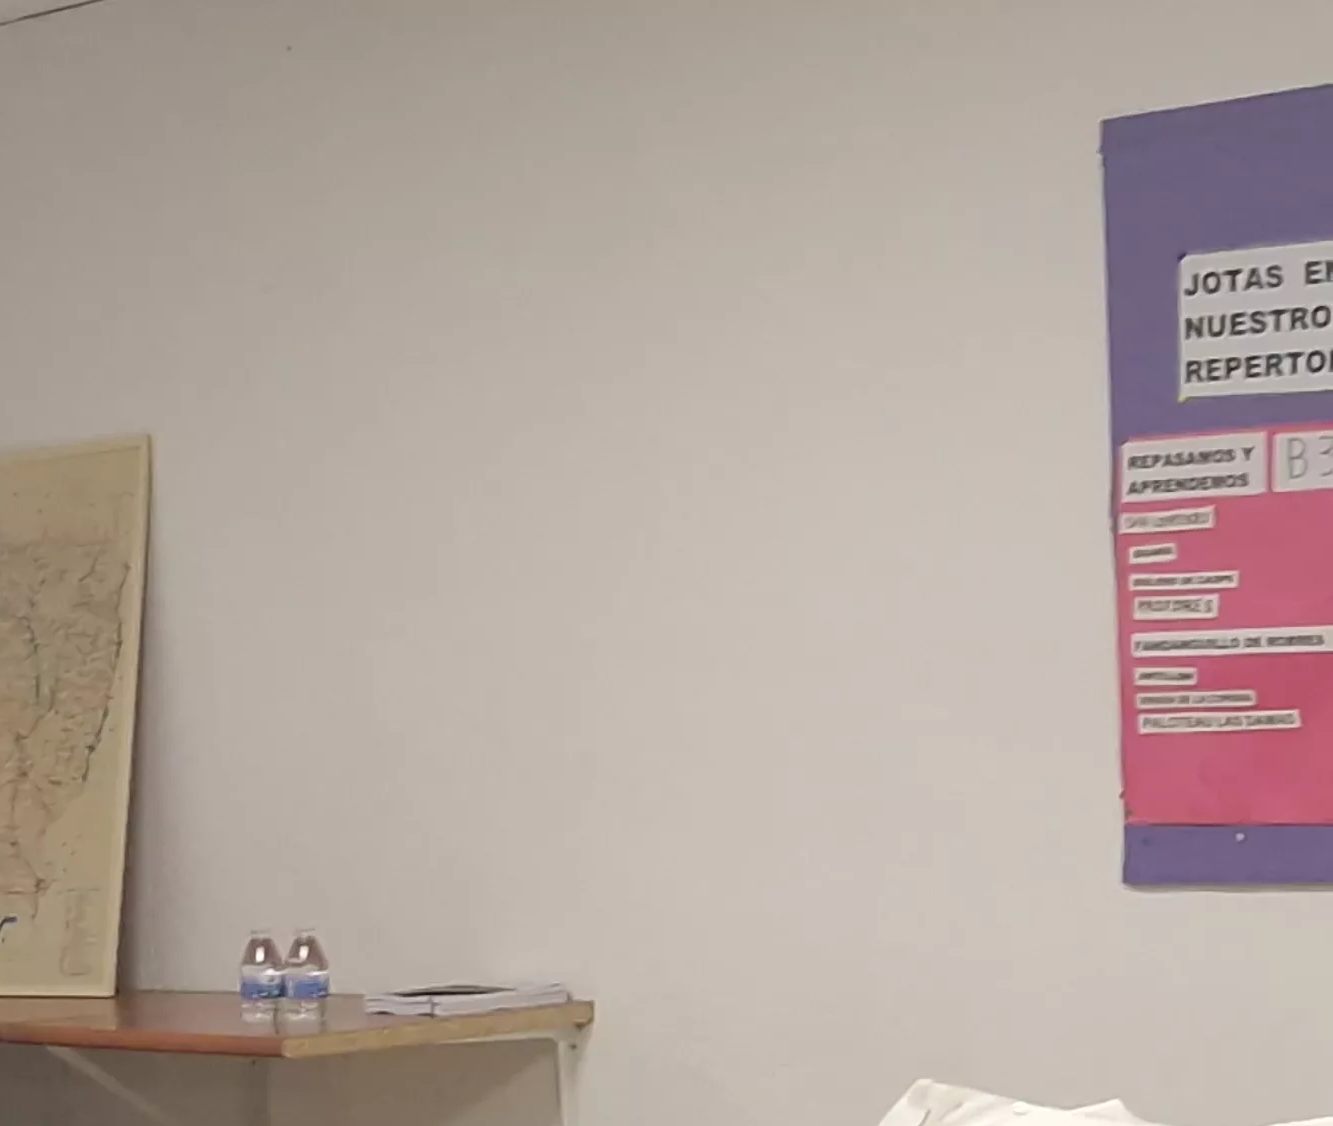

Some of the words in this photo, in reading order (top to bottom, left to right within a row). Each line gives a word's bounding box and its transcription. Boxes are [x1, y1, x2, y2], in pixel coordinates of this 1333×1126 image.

[1184, 264, 1283, 296] JOTAS
[1184, 305, 1332, 340] NUESTRO
[1127, 449, 1237, 470] REPASAMOS
[1240, 446, 1255, 462] Y
[1126, 472, 1250, 495] APRENDEMOS
